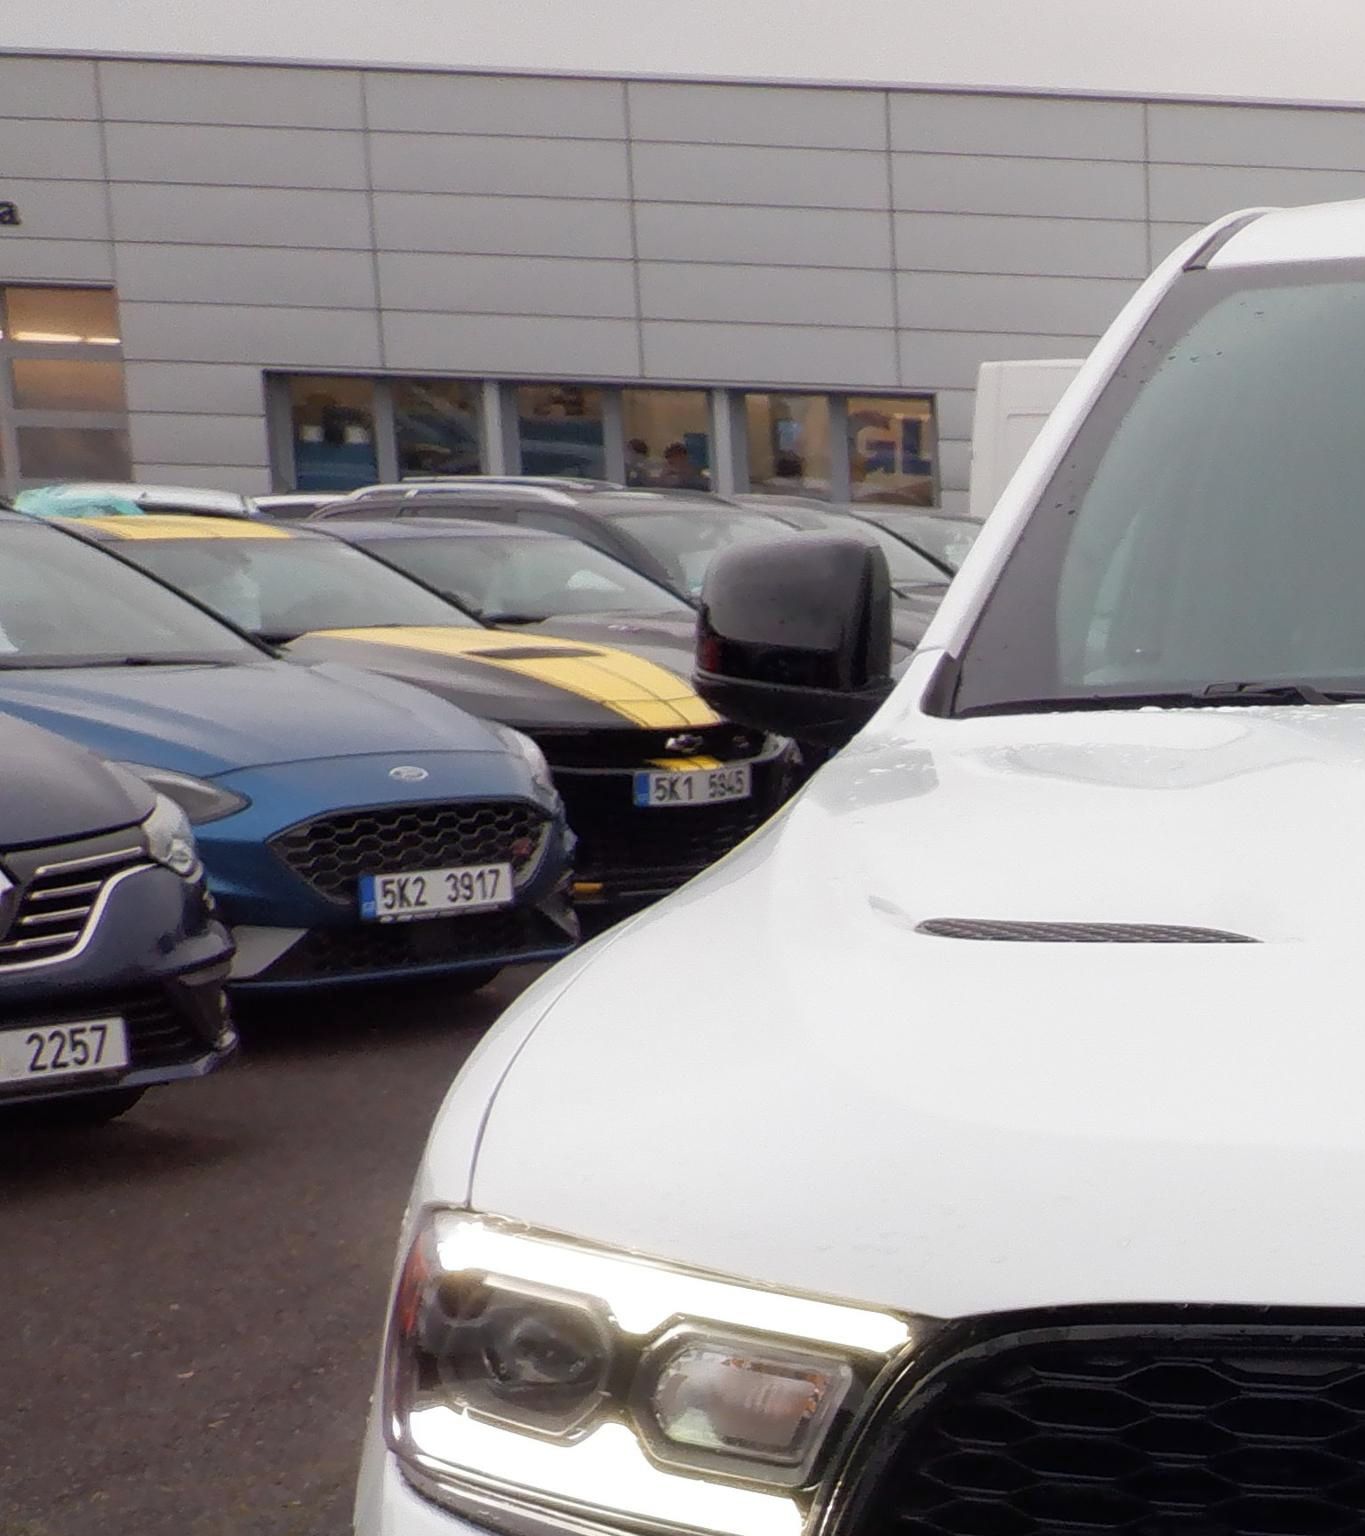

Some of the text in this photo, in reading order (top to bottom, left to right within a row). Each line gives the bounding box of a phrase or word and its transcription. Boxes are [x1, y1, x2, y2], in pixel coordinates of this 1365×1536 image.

[654, 775, 694, 802] 5K1
[381, 876, 428, 910] 5K2
[444, 868, 500, 902] 3917
[25, 1023, 108, 1072] 2257
